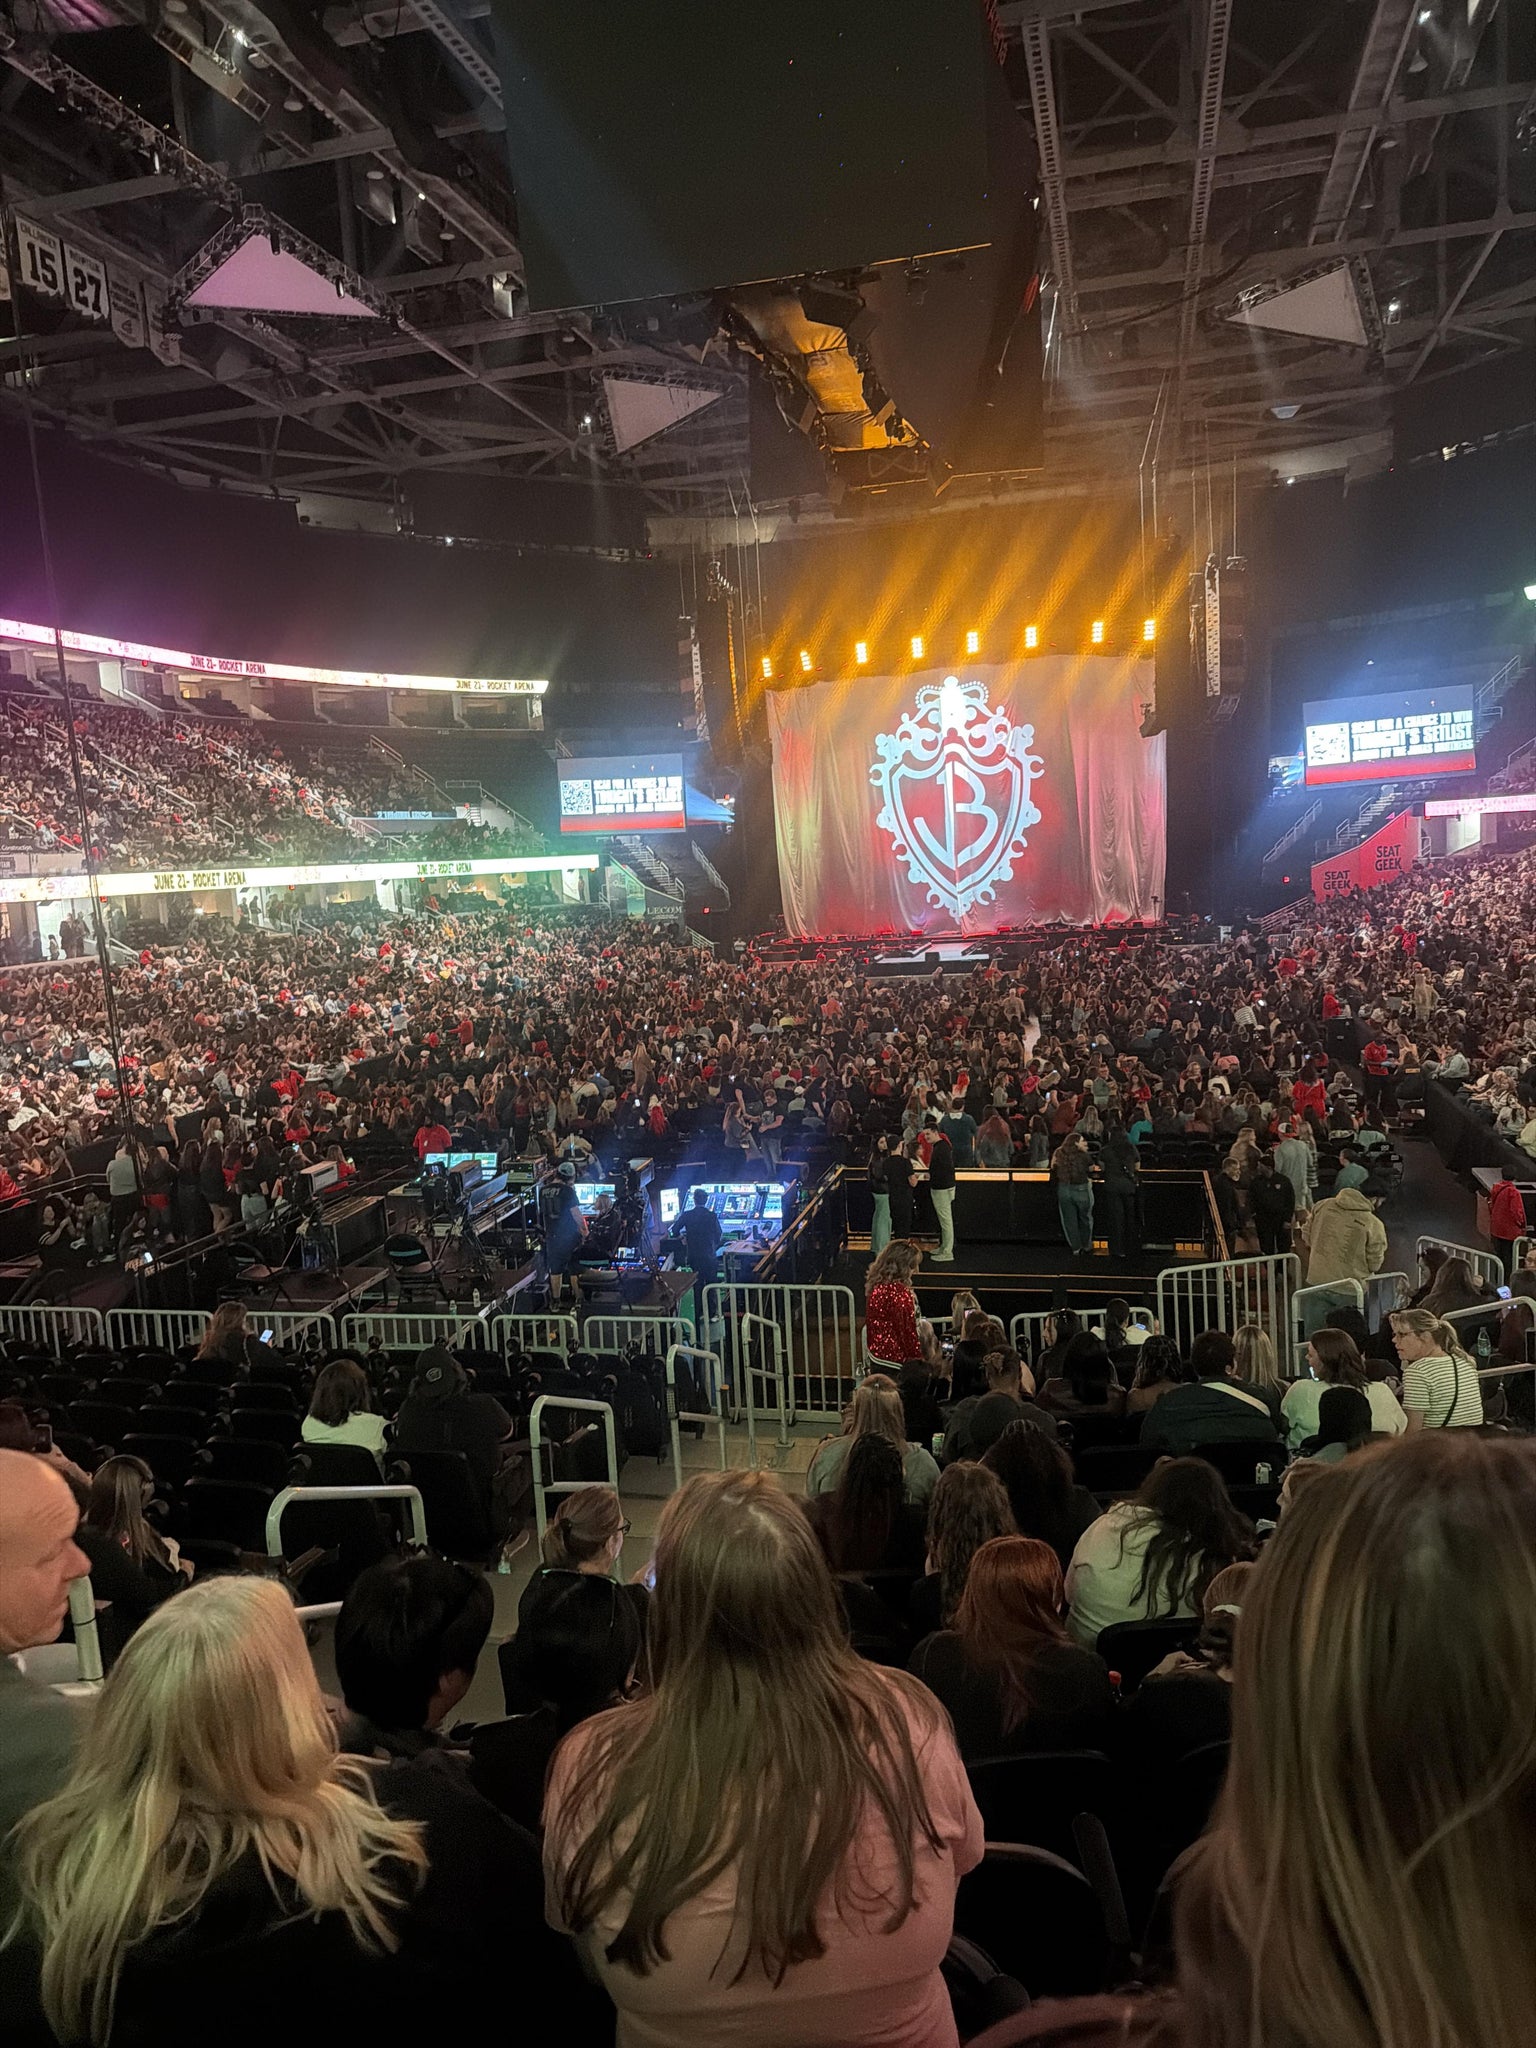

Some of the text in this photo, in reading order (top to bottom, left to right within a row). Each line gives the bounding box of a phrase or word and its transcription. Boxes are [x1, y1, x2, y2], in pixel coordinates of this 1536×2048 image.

[27, 242, 57, 290] 15
[73, 267, 102, 313] 27
[191, 656, 205, 668] JUNE
[219, 660, 243, 672] ROCKET
[246, 663, 266, 674] ARENA
[456, 680, 471, 689] JUNE
[487, 681, 511, 690] ROCKET
[514, 682, 534, 690] ARENA
[1423, 722, 1472, 743] SETLIST
[1376, 845, 1401, 858] SEAT
[1375, 858, 1402, 871] GEEK
[154, 874, 174, 890] JUNE
[192, 872, 220, 888] ROCKET
[224, 872, 247, 886] ARENA
[1324, 870, 1351, 880] SEAT
[1323, 880, 1351, 890] GEEK
[647, 905, 683, 914] LECOM
